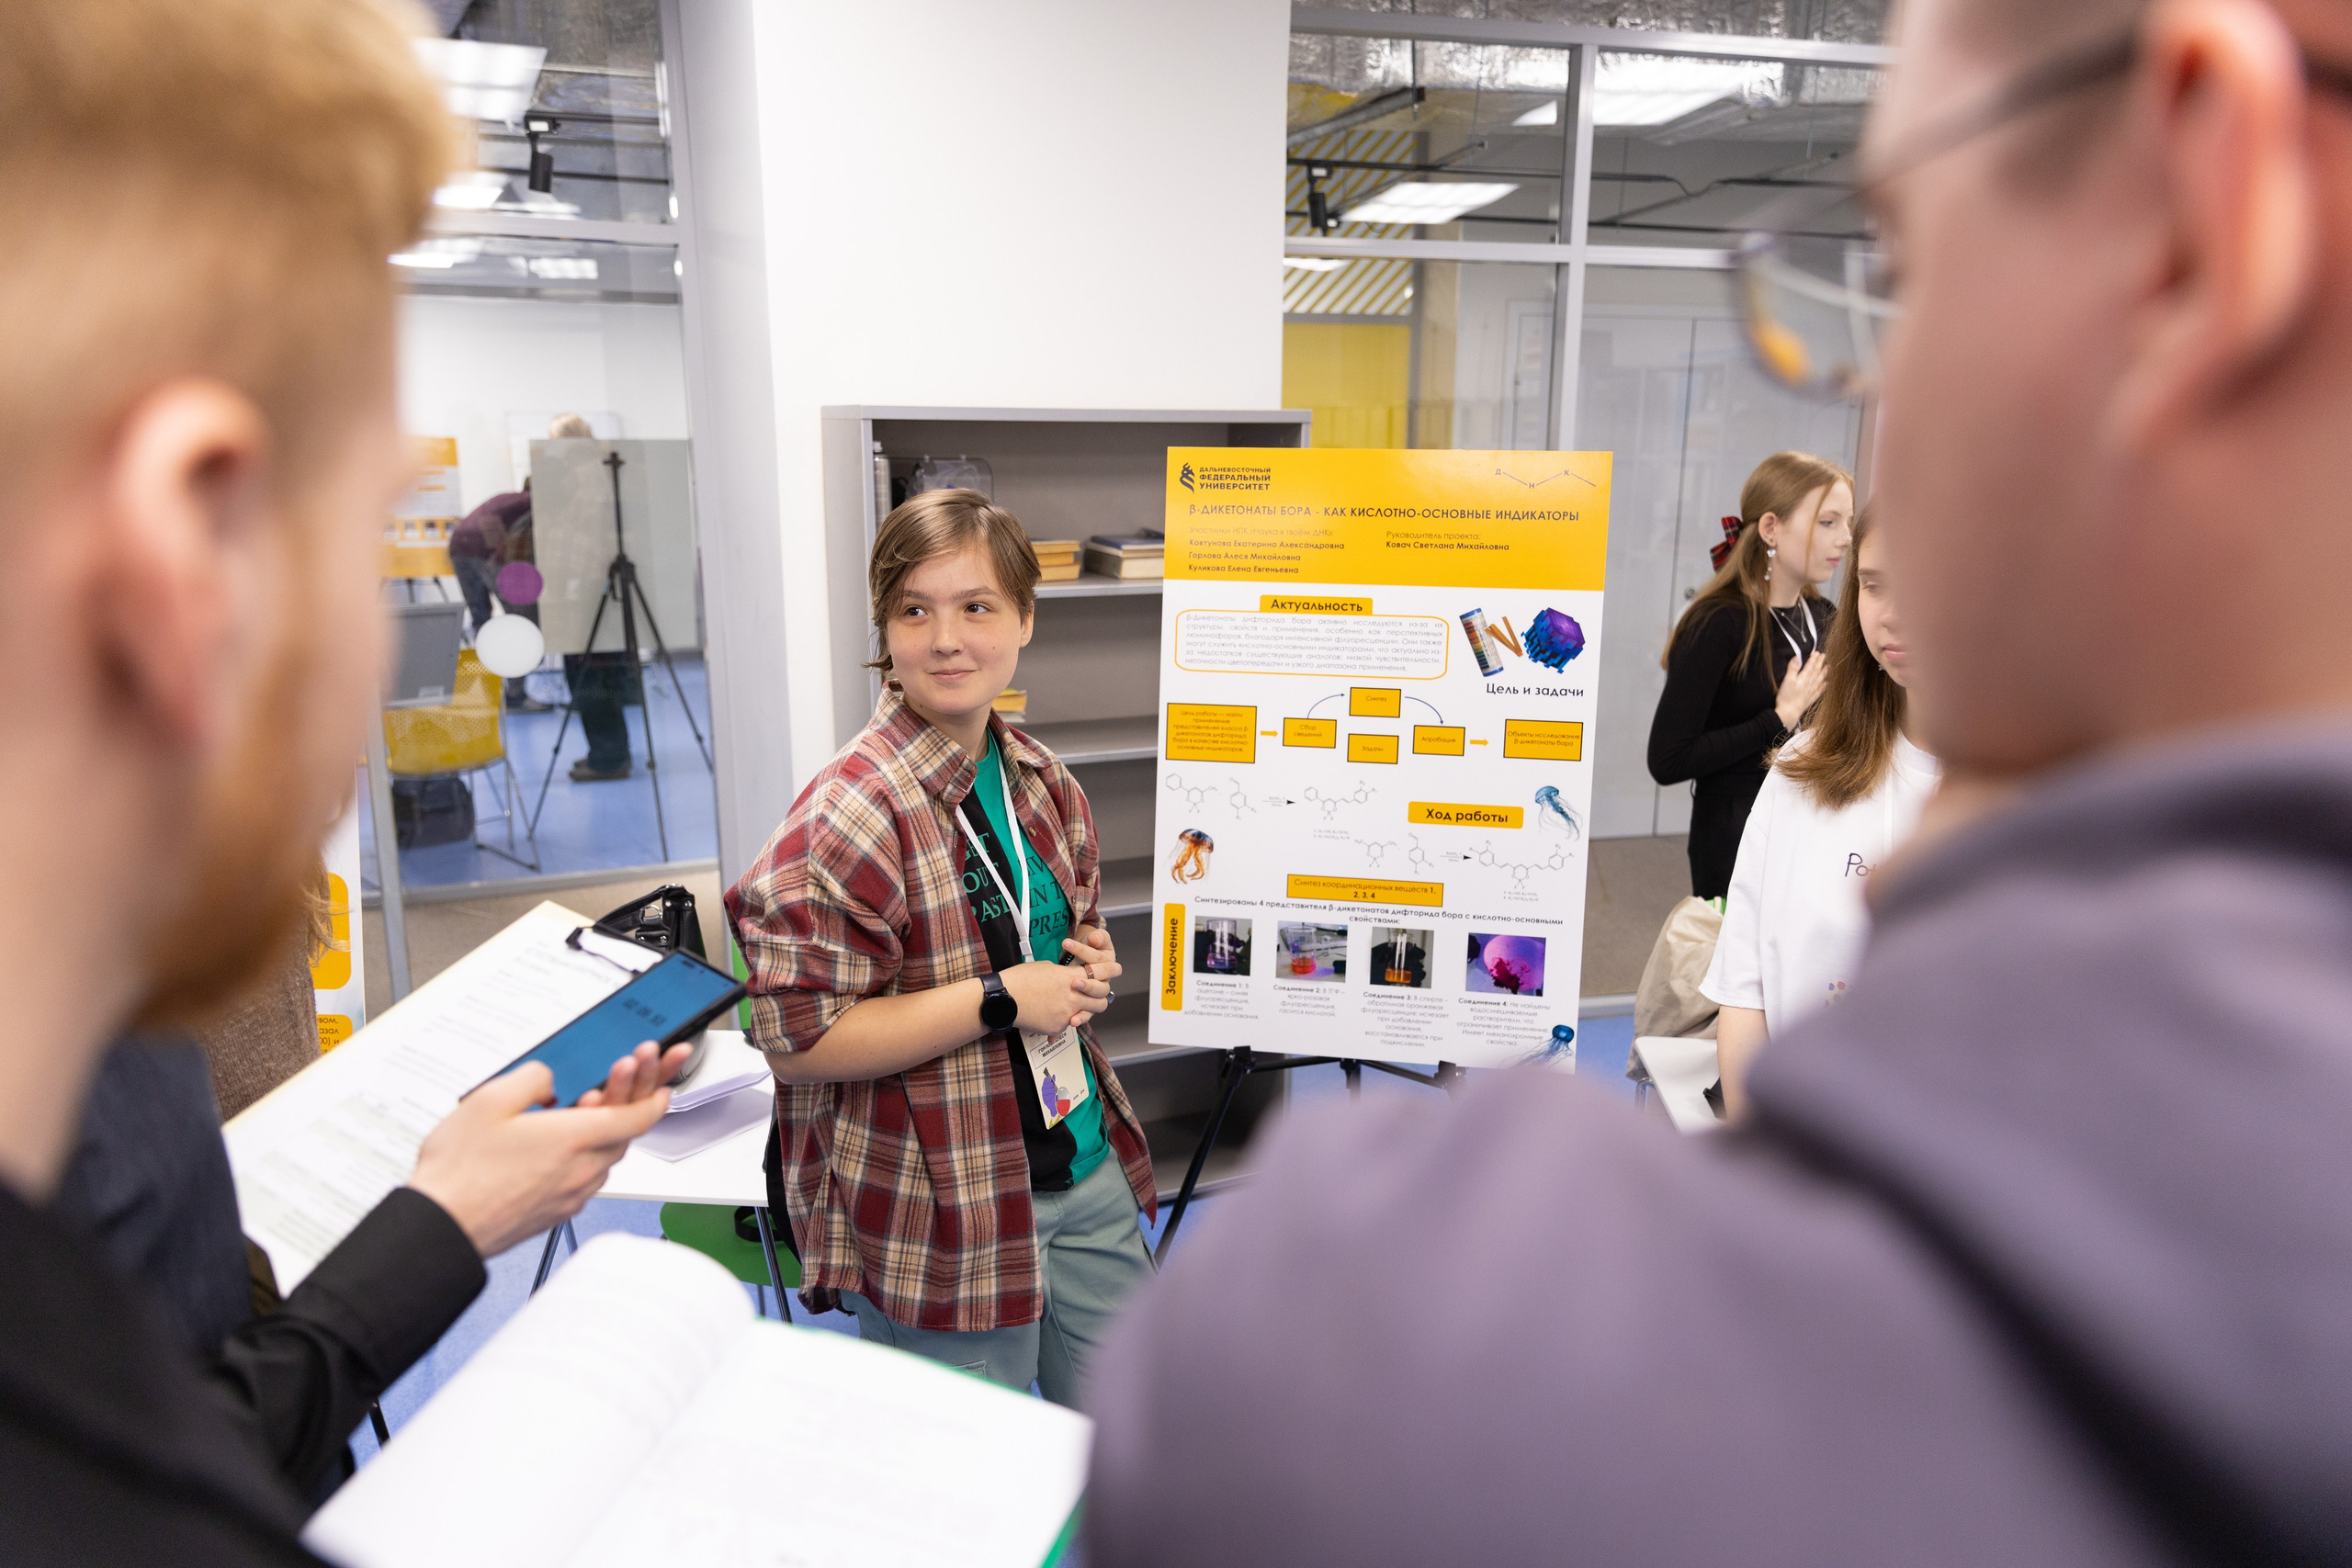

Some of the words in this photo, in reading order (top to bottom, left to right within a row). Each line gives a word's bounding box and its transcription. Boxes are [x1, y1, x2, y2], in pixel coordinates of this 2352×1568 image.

[1190, 504, 1276, 515] β-ДИКЕТОНАТЫ
[1279, 506, 1312, 516] БОРА
[1324, 507, 1346, 516] КАК
[1351, 508, 1491, 519] КИСЛОТНО-ОСНОВНЫЕ
[1496, 511, 1578, 521] ИНДИКАТОРЫ
[1386, 531, 1442, 539] Руководитель
[1234, 541, 1277, 549] Екатерина
[1279, 541, 1345, 550] Александровна
[1413, 541, 1454, 549] Светлана
[1189, 552, 1222, 560] Горлова
[1250, 553, 1301, 561] Михайловна
[1254, 566, 1299, 574] Евгеньевна
[1271, 599, 1363, 613] Актуальность
[1487, 683, 1519, 694] Цель
[1536, 687, 1584, 697] задачи
[1427, 809, 1452, 821] Ход
[1456, 811, 1508, 823] работы
[1845, 852, 1876, 877] Po
[1294, 878, 1321, 886] Синтез
[1322, 882, 1393, 891] координационных
[1194, 896, 1257, 906] Синтезированы
[1266, 902, 1327, 910] представителя
[1329, 904, 1389, 914] β-дикетонатов
[1391, 909, 1440, 918] дифторида
[1442, 911, 1463, 919] бора
[1473, 915, 1563, 925] кислотно-основными
[1165, 918, 1179, 996] Заключение
